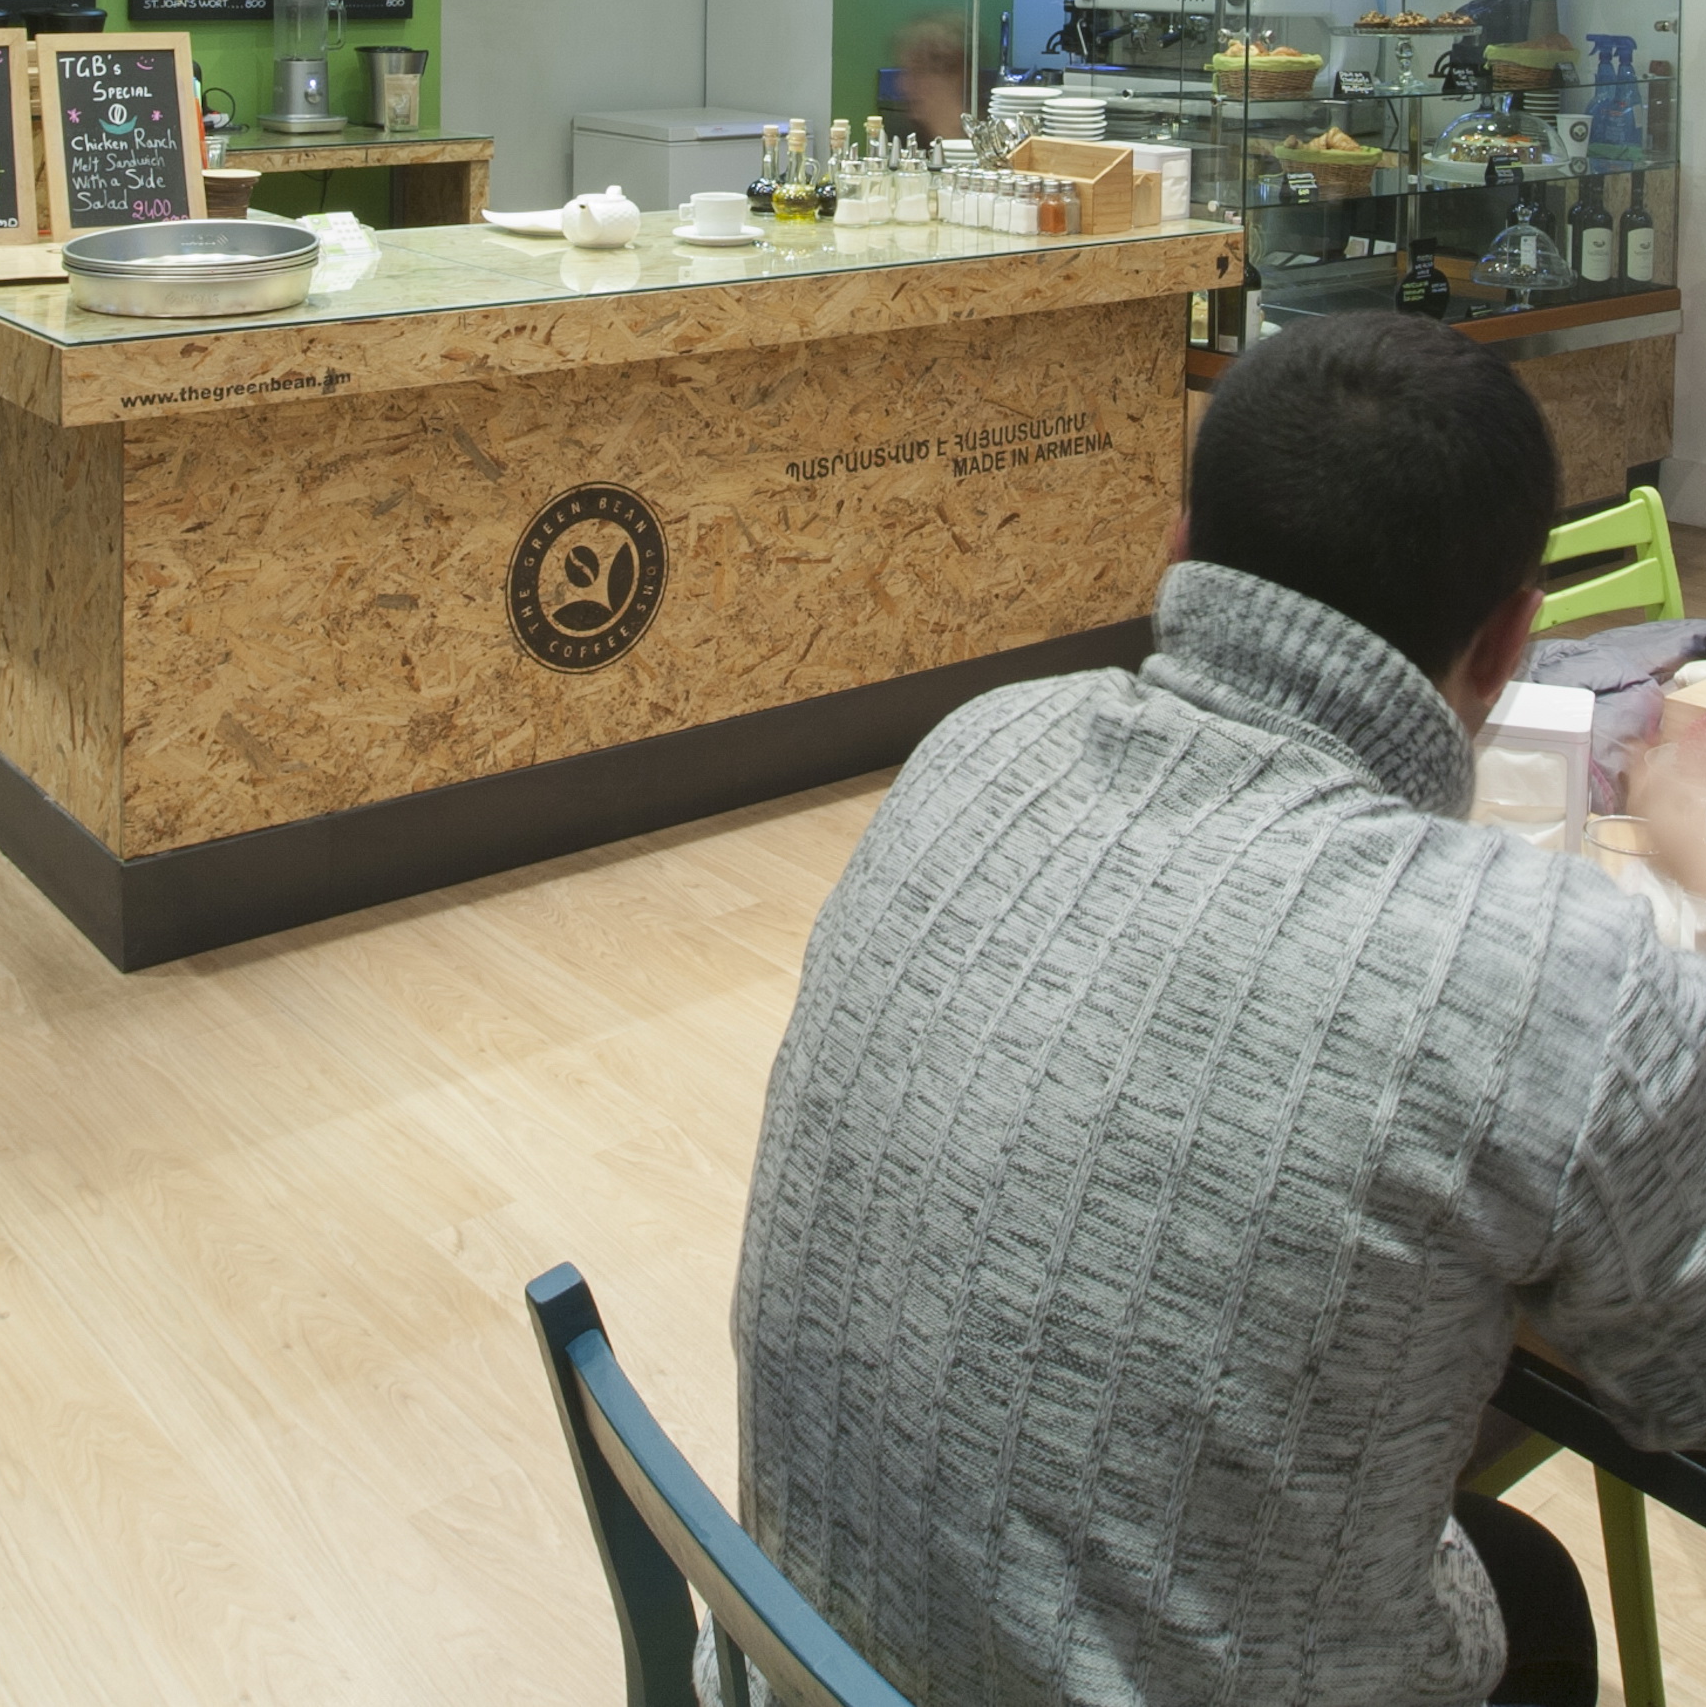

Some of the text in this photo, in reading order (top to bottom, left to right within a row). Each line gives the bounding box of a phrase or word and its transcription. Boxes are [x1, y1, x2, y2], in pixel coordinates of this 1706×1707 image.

[198, 0, 266, 9] WORT 800
[59, 54, 122, 79] TGB's
[71, 127, 177, 152] Chicken Ranch
[71, 151, 165, 173] Melt Sandwich
[111, 178, 121, 187] a
[126, 169, 166, 189] Side
[73, 191, 129, 211] Salad
[132, 199, 172, 221] 2400
[120, 373, 351, 408] www.thegreenbean.am
[953, 431, 1114, 478] MADE IN ARMENIA
[519, 497, 648, 634] THE GREEN BEAN
[549, 549, 657, 658] COFFEE SHOP
